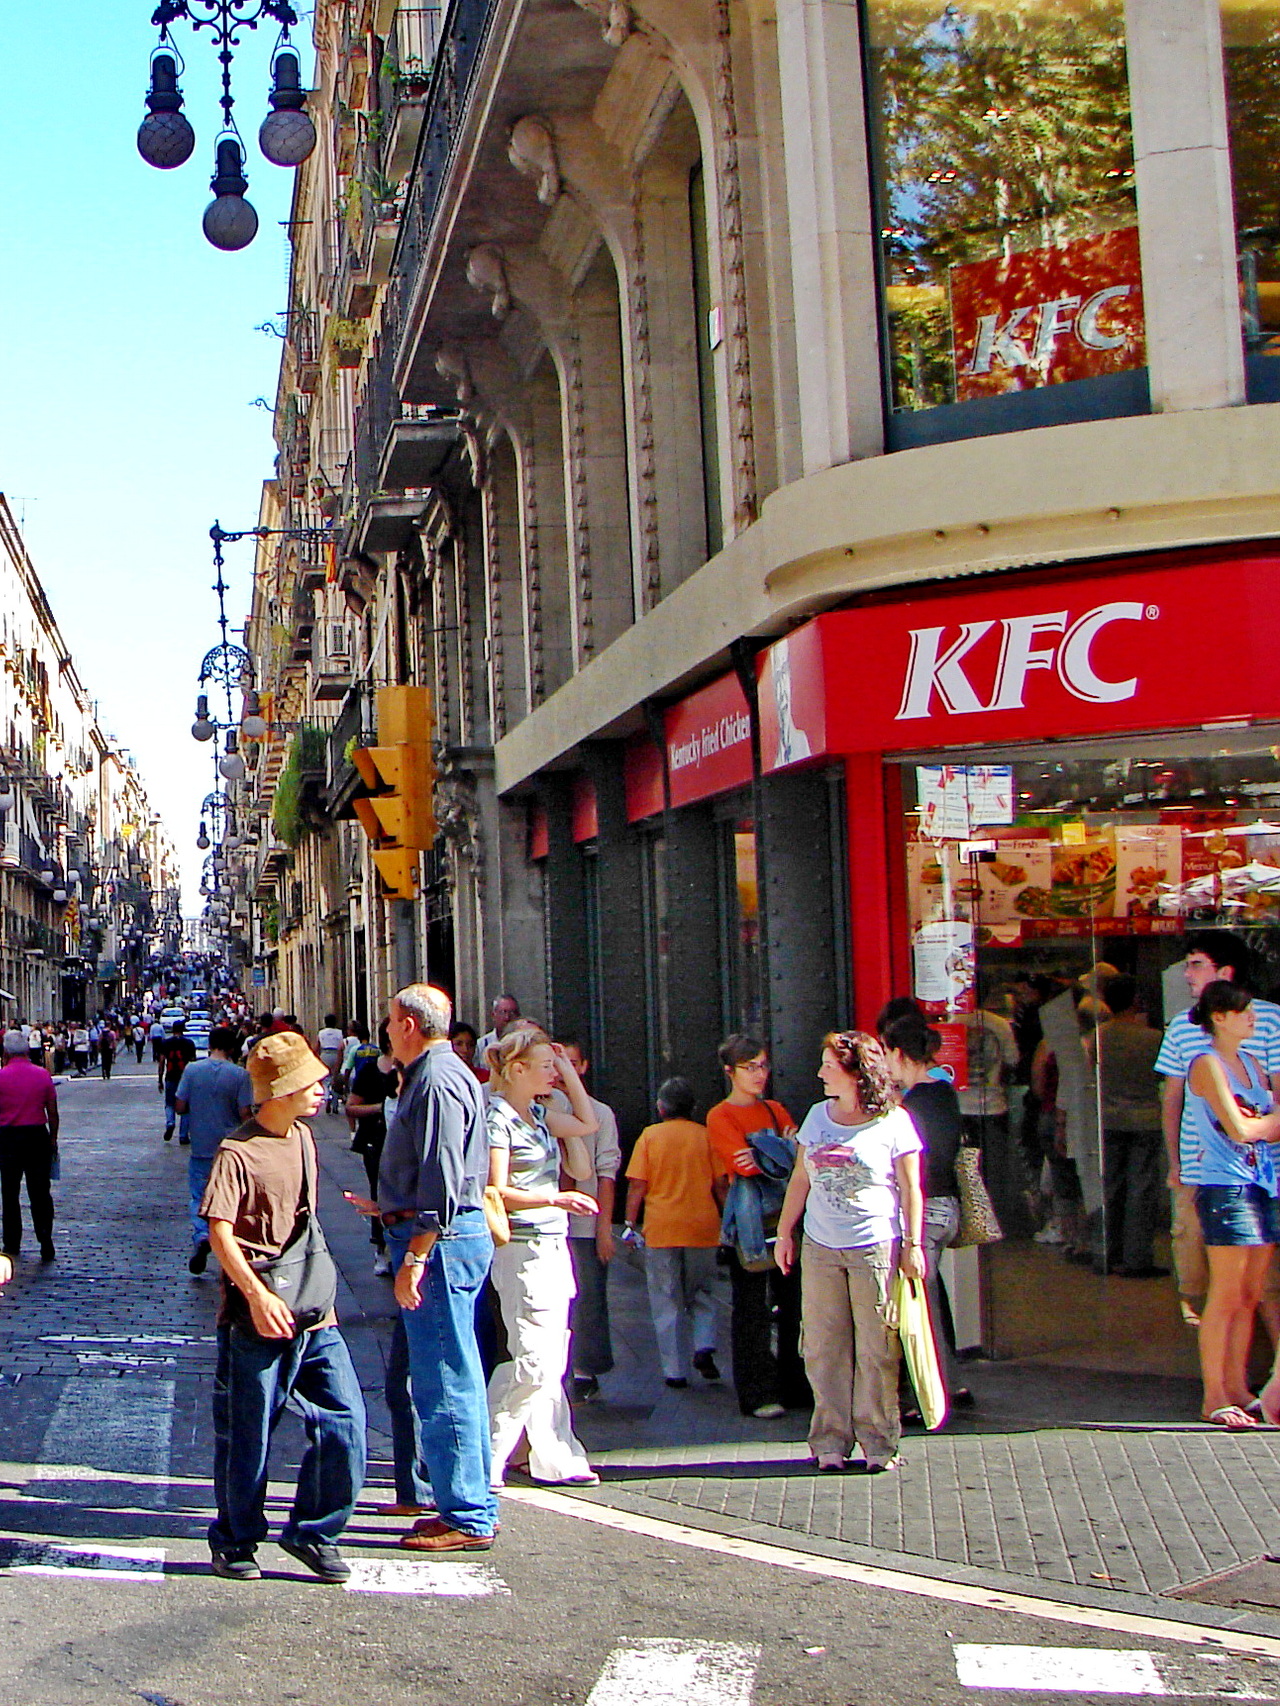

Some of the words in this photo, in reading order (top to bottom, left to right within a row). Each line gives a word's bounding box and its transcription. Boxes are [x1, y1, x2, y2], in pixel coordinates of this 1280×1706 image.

[959, 285, 1131, 376] KFC
[894, 601, 1145, 720] KFC
[671, 732, 700, 771] Kentucky
[701, 721, 720, 758] Fried
[720, 711, 751, 749] Chicken
